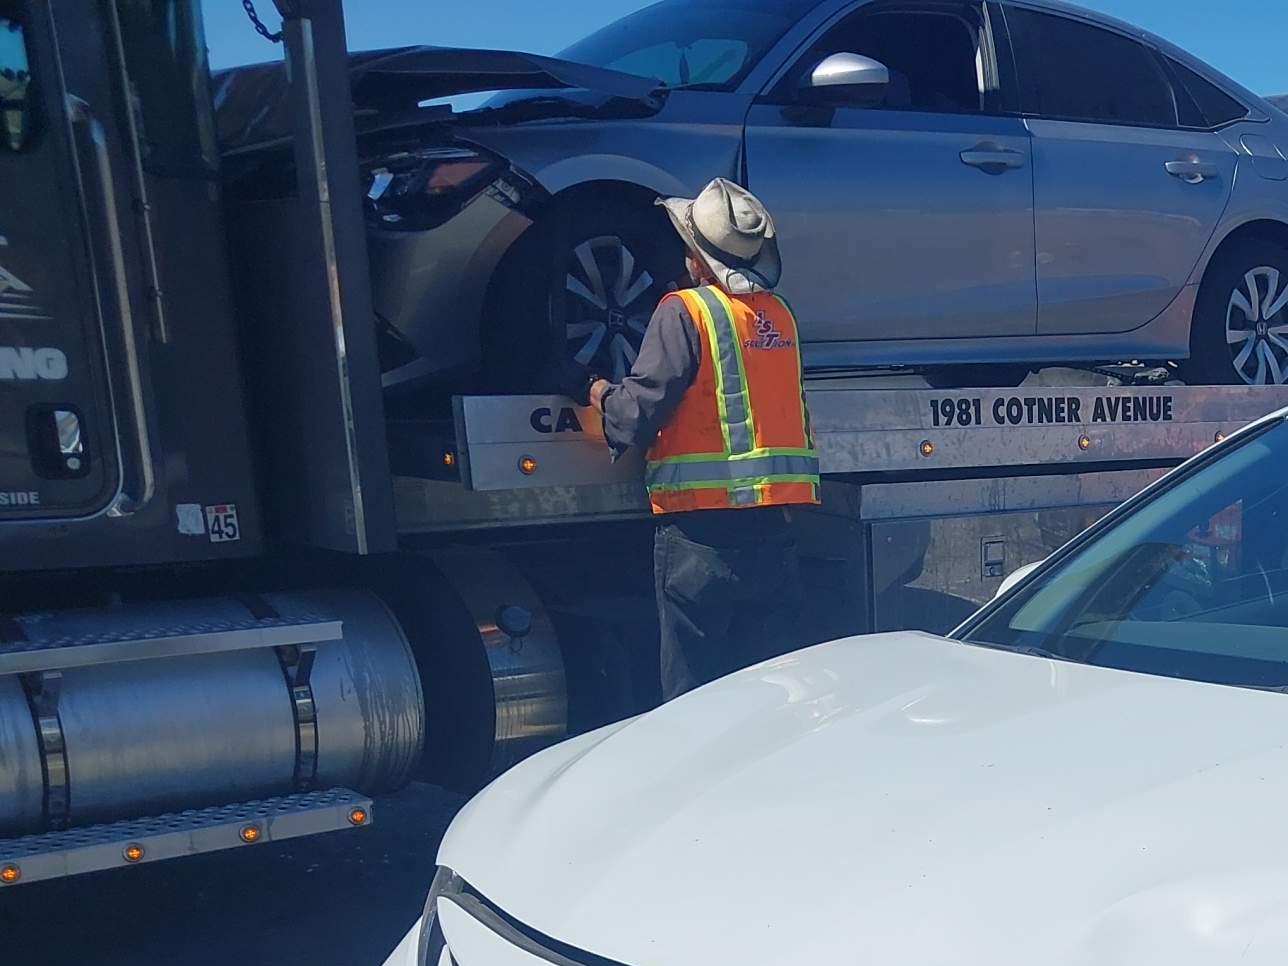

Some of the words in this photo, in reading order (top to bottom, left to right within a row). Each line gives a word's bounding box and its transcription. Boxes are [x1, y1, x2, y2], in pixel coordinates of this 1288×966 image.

[529, 407, 584, 434] CA
[929, 398, 982, 427] 1981
[992, 397, 1081, 425] COTNER
[1091, 396, 1173, 423] AVENUE
[211, 513, 237, 539] 45
